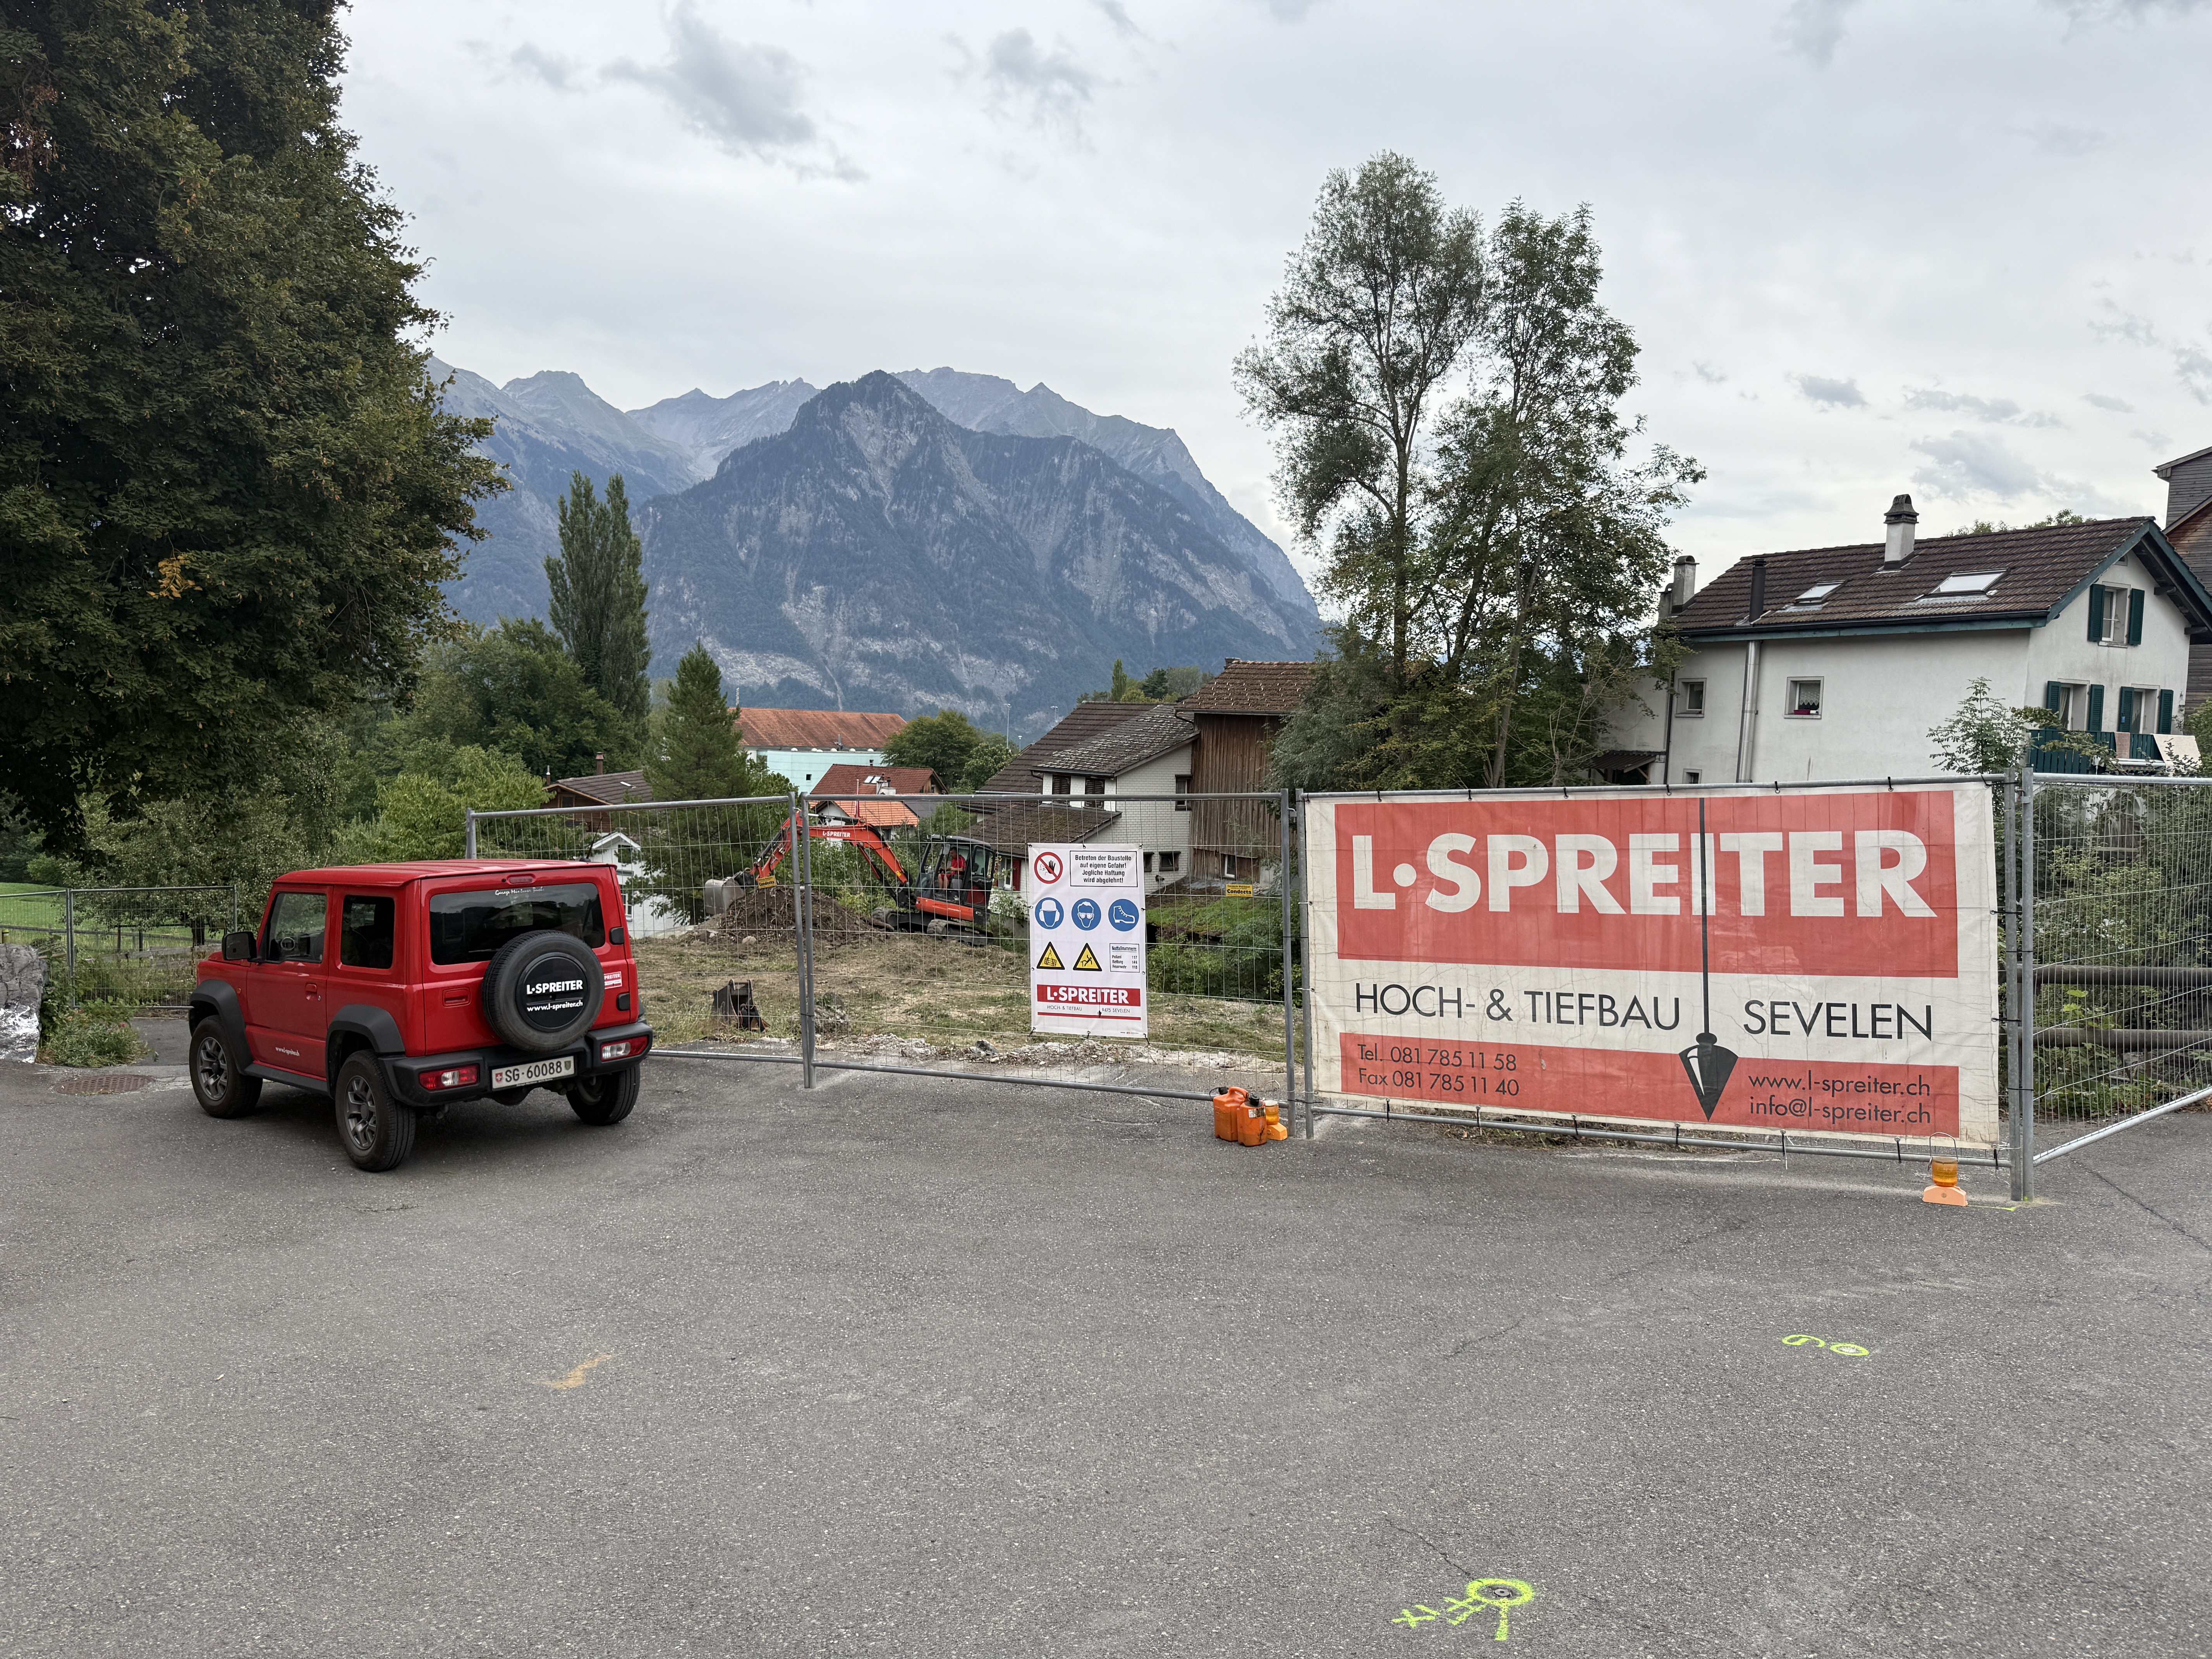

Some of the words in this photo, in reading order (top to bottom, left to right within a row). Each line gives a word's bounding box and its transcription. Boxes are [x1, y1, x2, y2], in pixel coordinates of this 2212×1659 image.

[527, 1000, 583, 1012] www.l-spreiter.ch
[1356, 983, 1475, 1018] HOCH-
[1486, 989, 1513, 1021] &
[1524, 991, 1679, 1030] TIEFBAU
[1743, 1000, 1932, 1041] SEVELEN
[1357, 1043, 1383, 1061] Tel.
[1391, 1046, 1420, 1064] 081
[1427, 1049, 1462, 1067] 785
[1469, 1052, 1484, 1069] 11
[1493, 1053, 1517, 1071] 58
[1359, 1068, 1388, 1085] Fax
[1392, 1070, 1421, 1088] 081
[1430, 1073, 1464, 1092] 785
[1472, 1076, 1486, 1093] 11
[1495, 1079, 1519, 1096] 40
[1748, 1070, 1930, 1097] www.l-spreiter.ch
[1750, 1095, 1931, 1124] info@l-spreiter.ch
